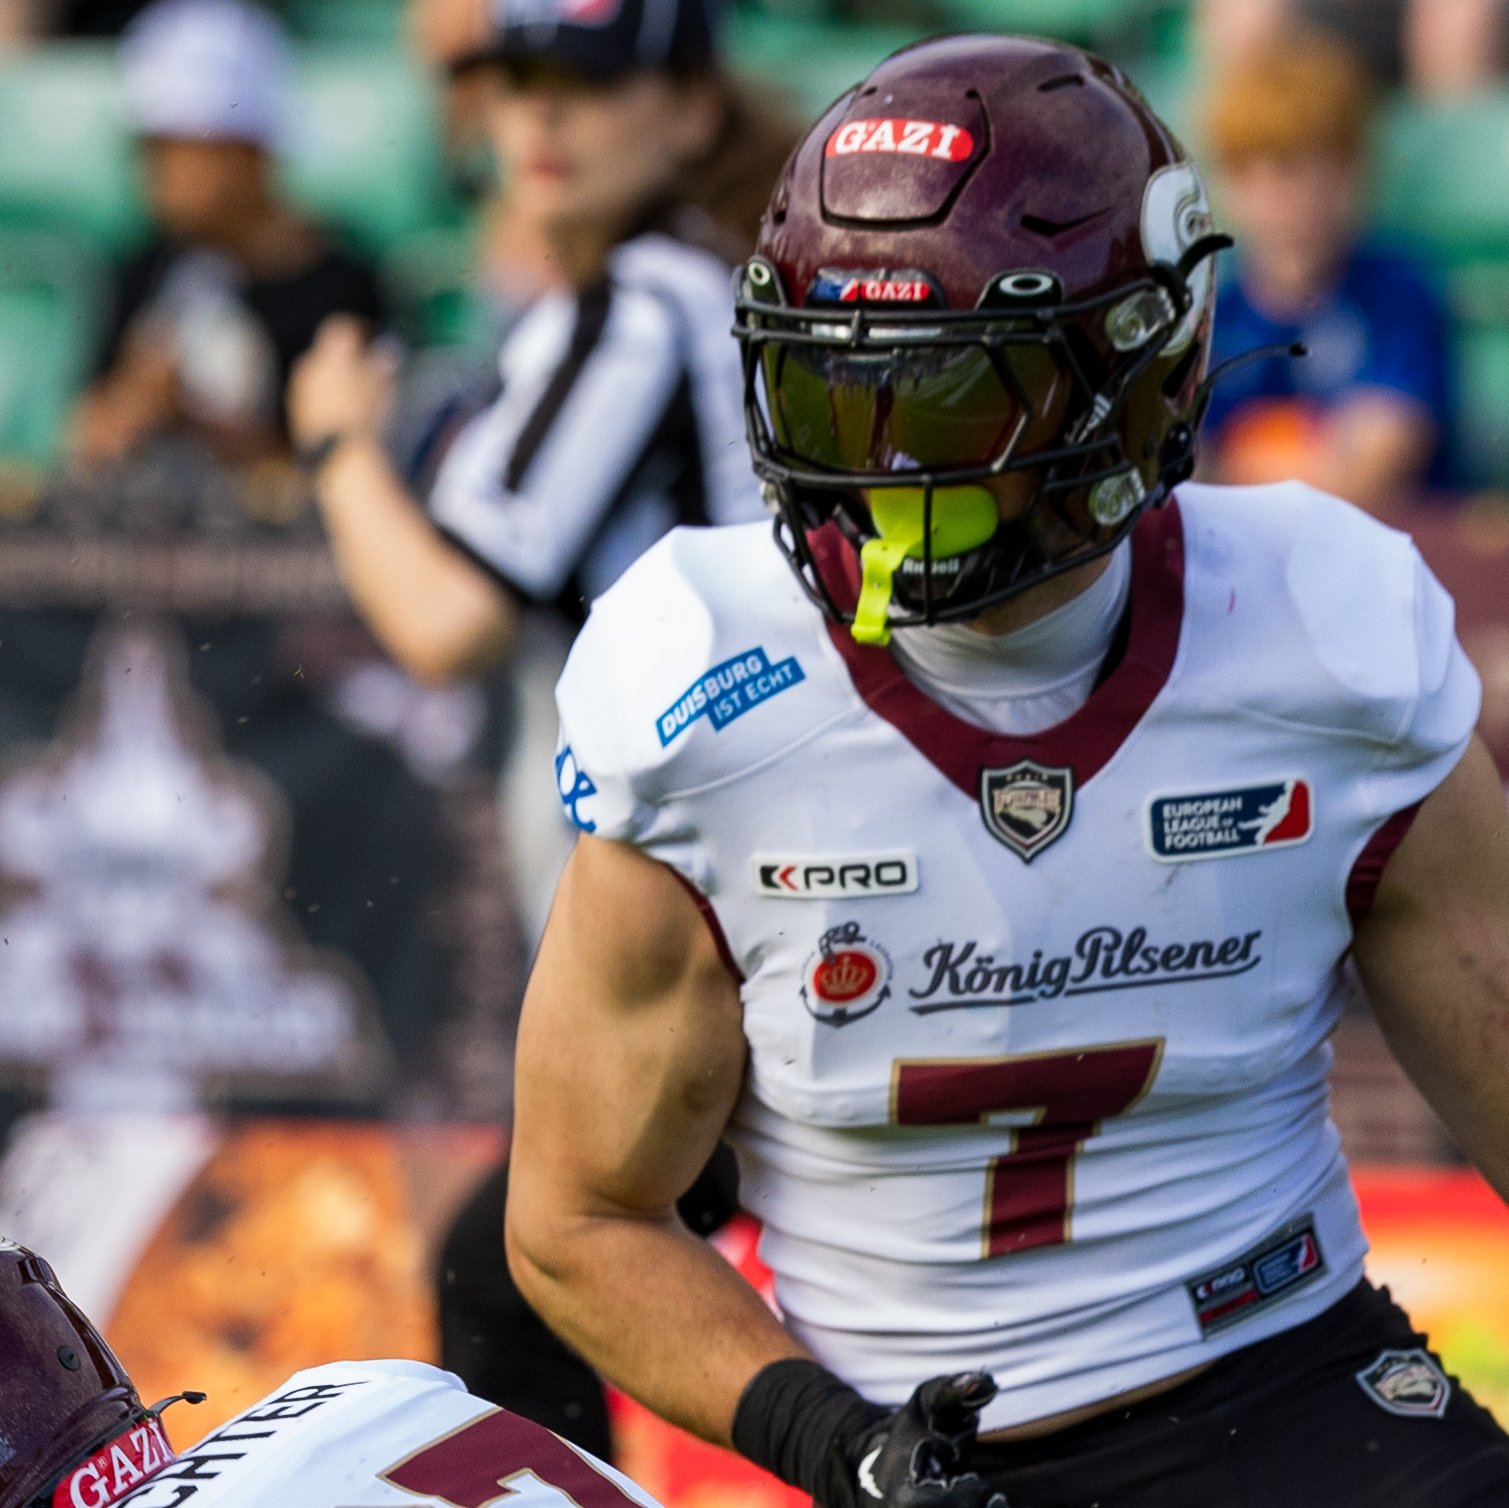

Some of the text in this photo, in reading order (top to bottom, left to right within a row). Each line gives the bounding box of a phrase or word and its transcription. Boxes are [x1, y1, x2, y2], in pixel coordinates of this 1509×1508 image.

[660, 654, 763, 739] DUISBURG
[712, 662, 794, 722] IST ECHT
[1162, 797, 1243, 819] EUROPEAN
[1164, 815, 1219, 834] LEAGUE
[1164, 828, 1241, 851] FOOTBALL
[909, 940, 1072, 999] König
[1070, 926, 1262, 993] Pilsener
[890, 1037, 1166, 1260] 7
